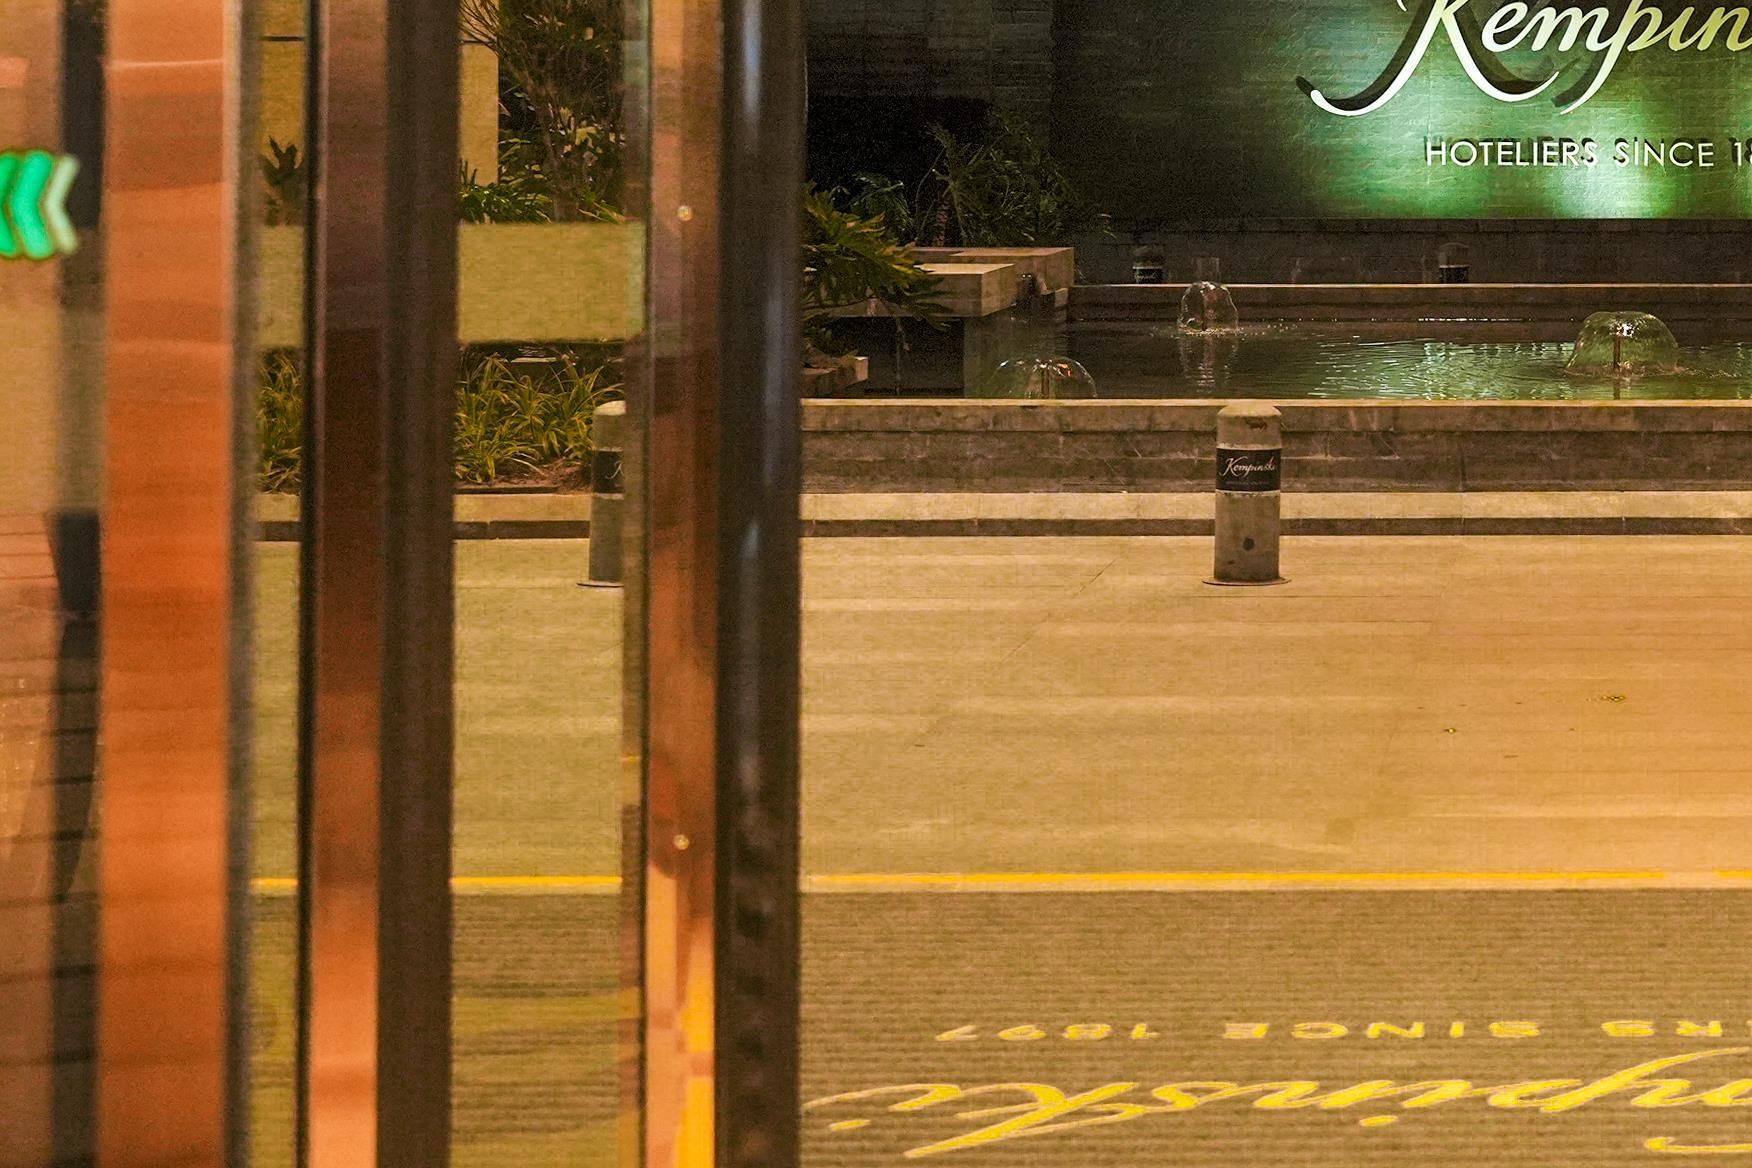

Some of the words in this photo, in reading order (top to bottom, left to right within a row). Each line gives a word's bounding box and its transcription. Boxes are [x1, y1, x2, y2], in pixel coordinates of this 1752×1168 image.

[1426, 141, 1599, 168] HOTELIERS
[1613, 141, 1715, 168] SINCE
[935, 1022, 1160, 1041] 1897
[1222, 1019, 1542, 1040] SINCE
